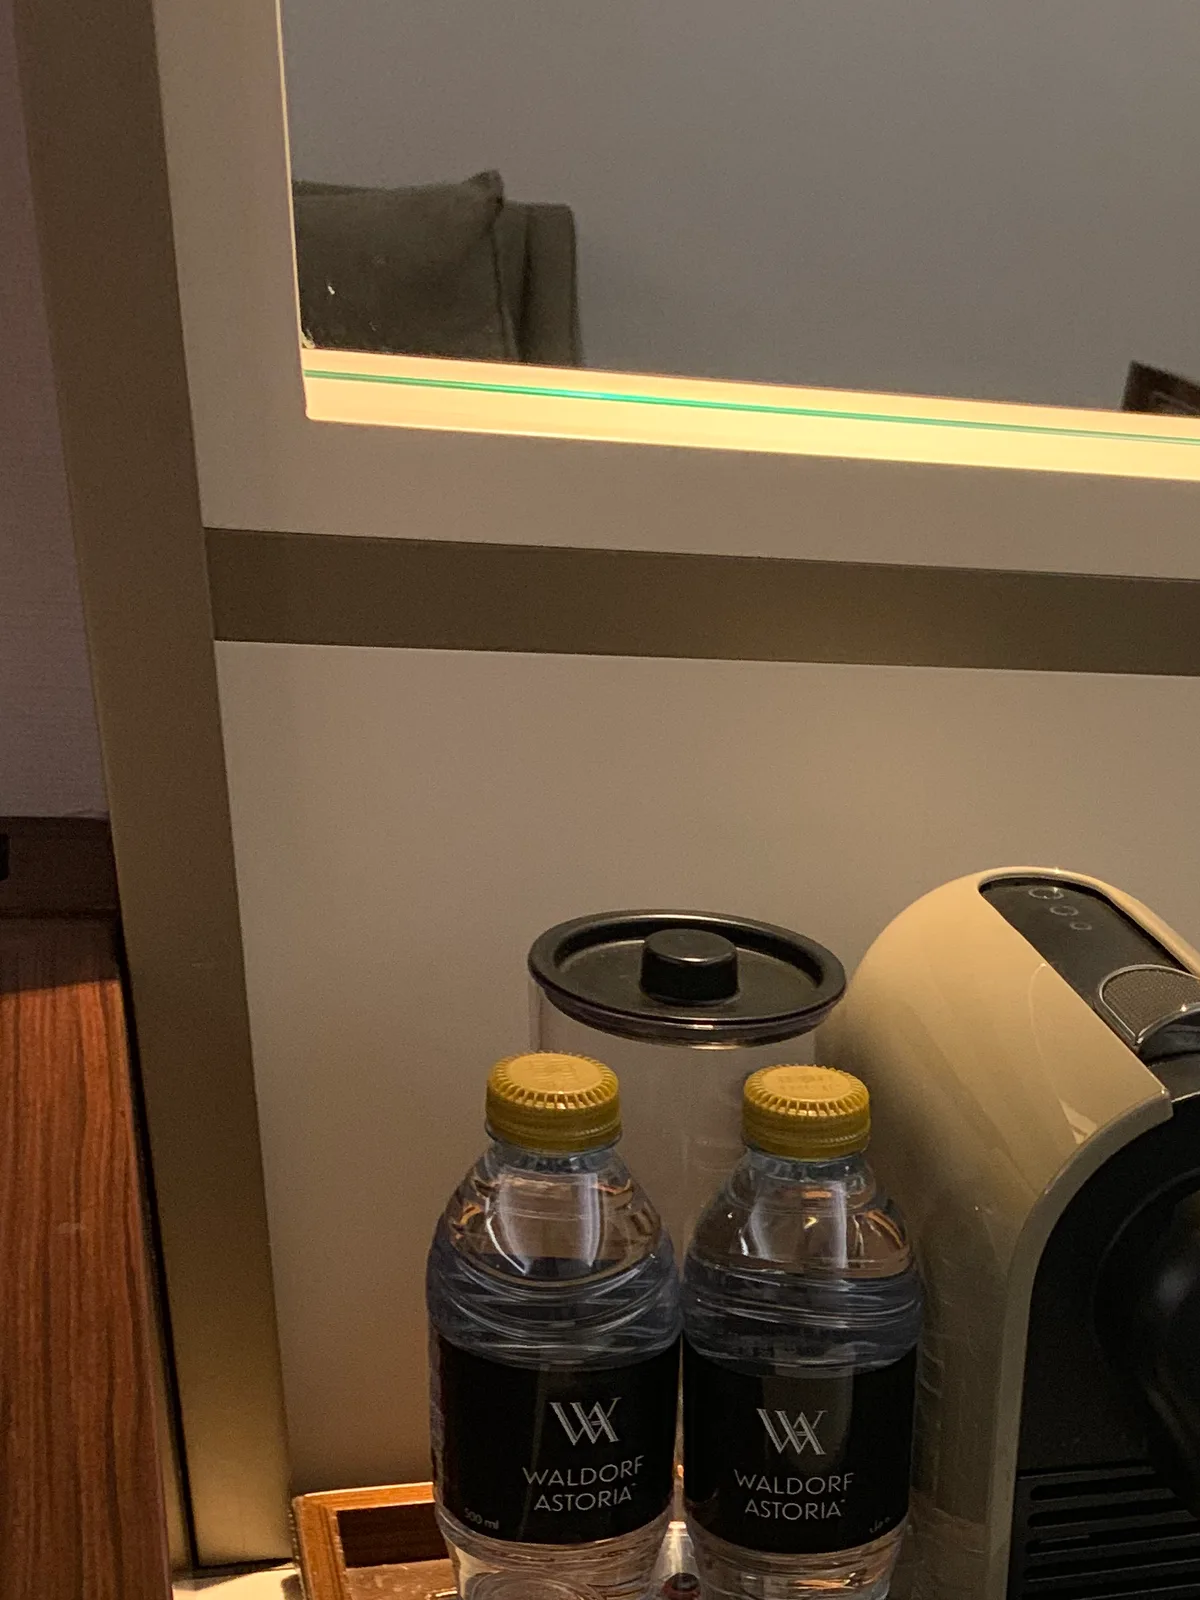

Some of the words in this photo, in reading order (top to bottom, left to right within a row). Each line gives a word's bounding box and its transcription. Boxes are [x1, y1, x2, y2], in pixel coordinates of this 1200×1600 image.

[522, 1455, 645, 1487] WALDORF
[733, 1468, 855, 1495] WALDORF
[533, 1485, 633, 1512] ASTORIA
[744, 1498, 842, 1521] ASTORIA
